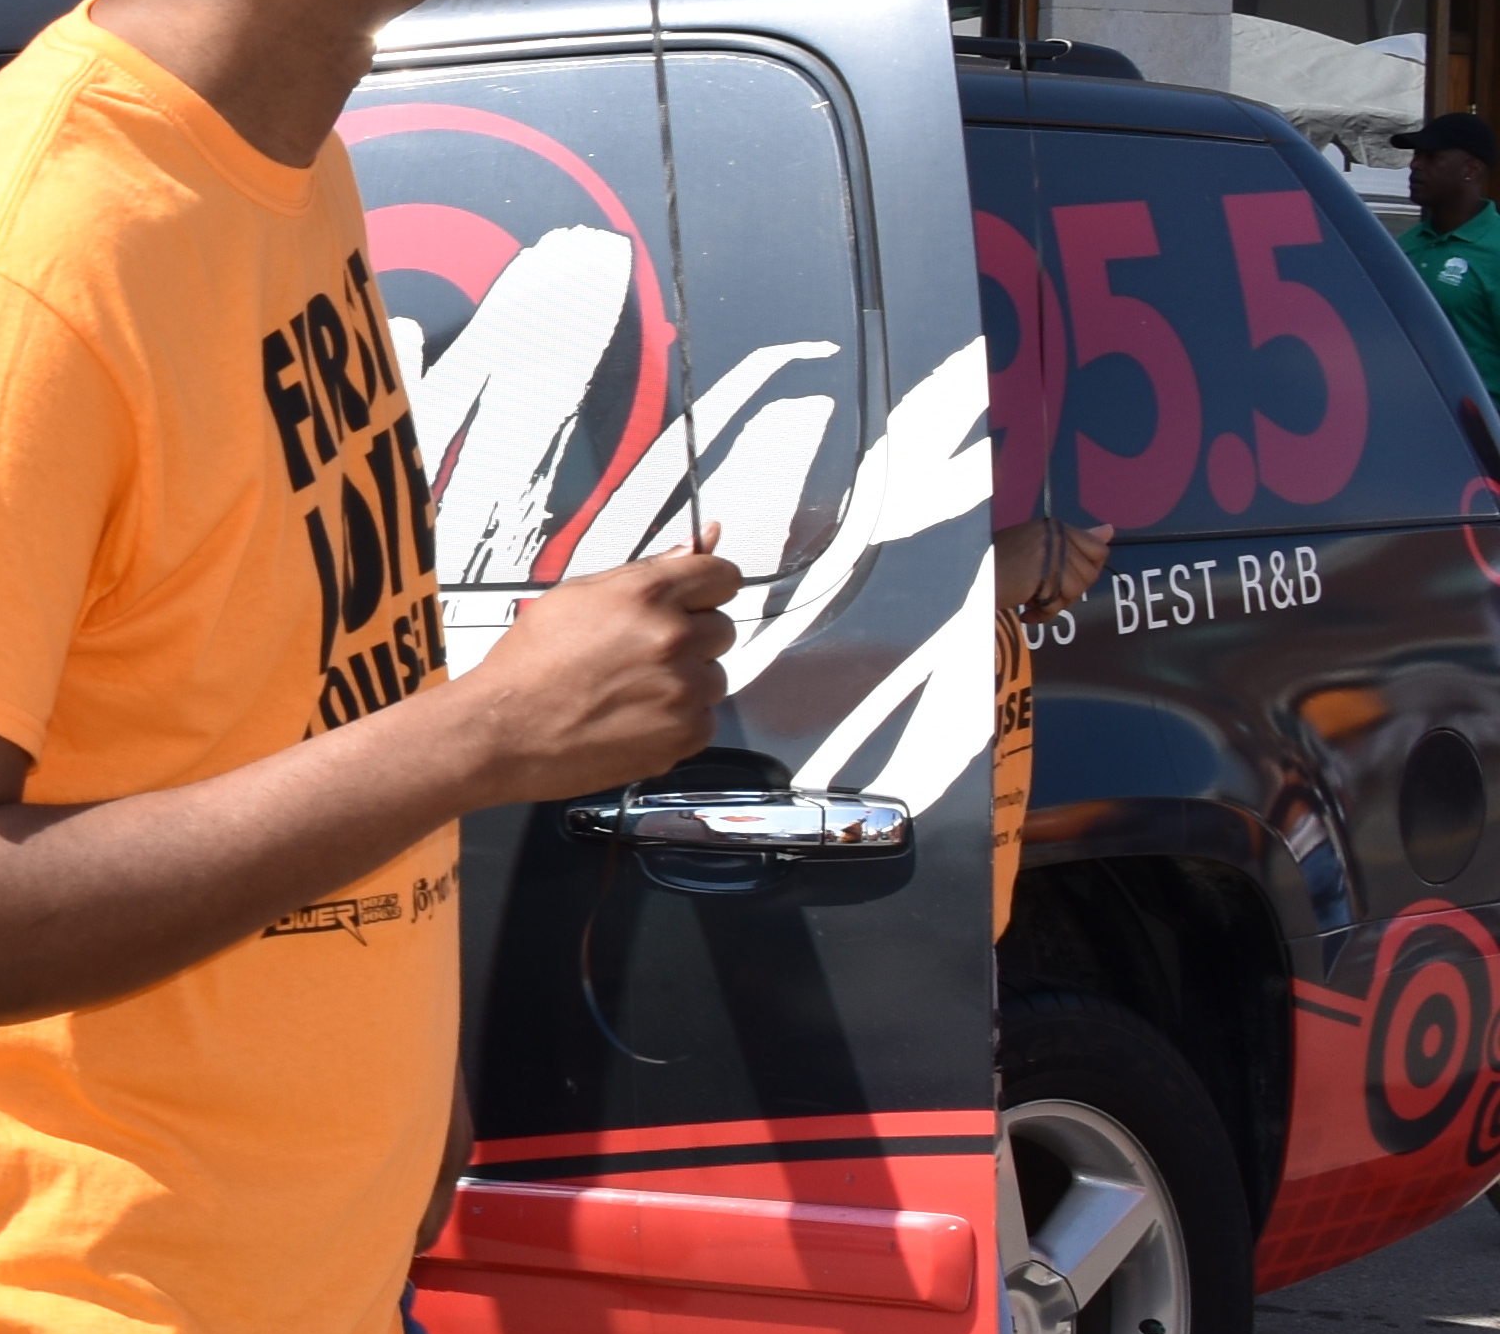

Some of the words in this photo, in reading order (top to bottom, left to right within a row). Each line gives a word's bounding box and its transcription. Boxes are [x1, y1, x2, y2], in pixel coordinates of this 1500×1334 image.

[261, 247, 397, 493] FIRST
[972, 188, 1369, 533] 95.5
[1112, 558, 1218, 637] BEST
[1240, 545, 1323, 616] R&B
